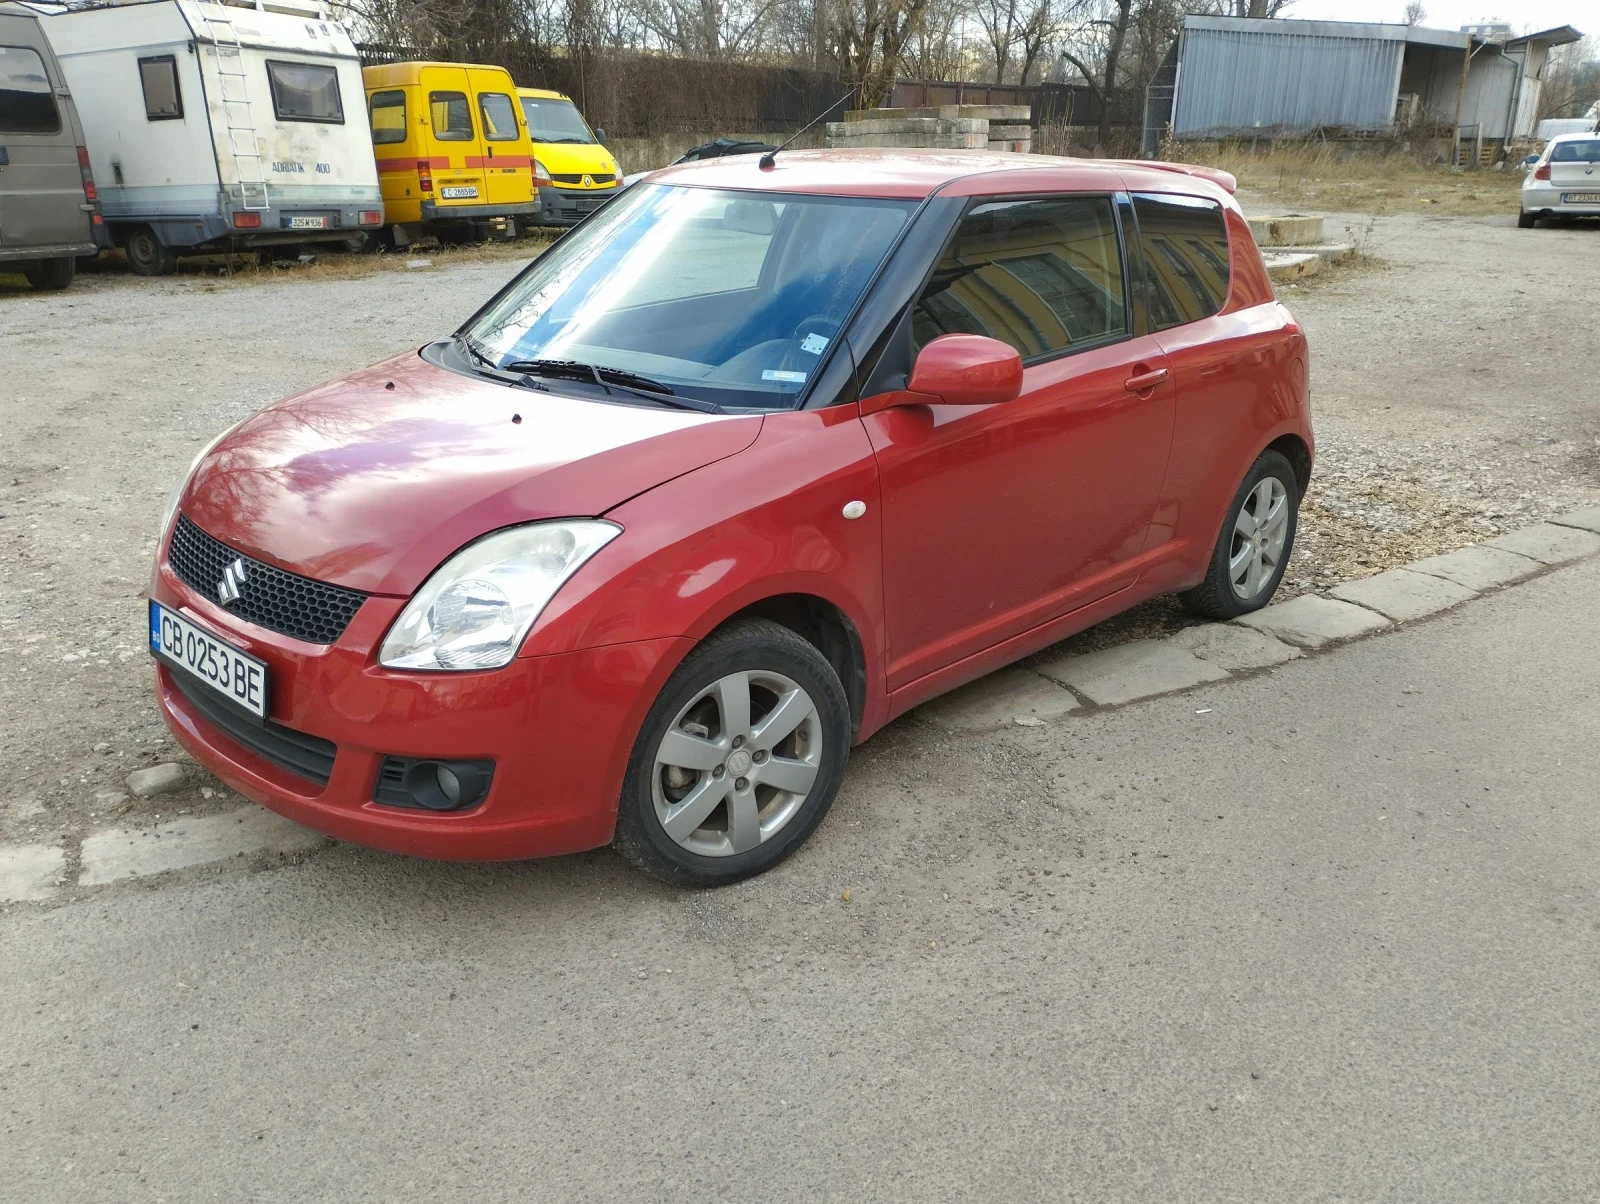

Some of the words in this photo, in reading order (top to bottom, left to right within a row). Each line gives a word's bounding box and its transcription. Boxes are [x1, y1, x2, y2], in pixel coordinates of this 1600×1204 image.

[272, 162, 305, 173] ADRIATIK
[315, 163, 331, 174] 400
[162, 615, 183, 659] CB
[187, 631, 230, 688] 0253
[234, 657, 260, 709] BE
